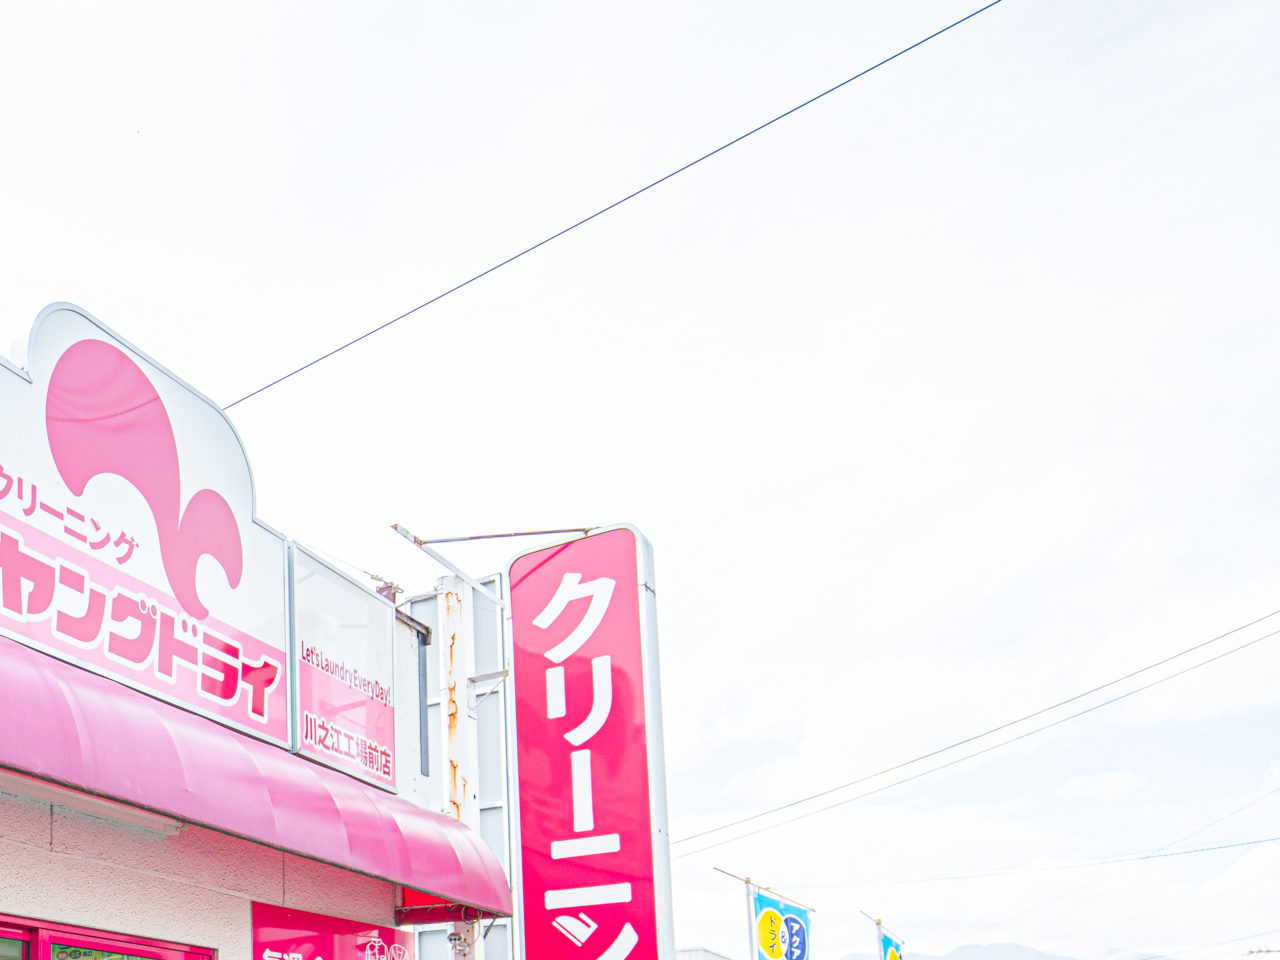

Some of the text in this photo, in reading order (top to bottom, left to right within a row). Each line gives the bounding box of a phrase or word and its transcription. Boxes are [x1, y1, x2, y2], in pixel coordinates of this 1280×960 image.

[304, 713, 392, 776] 川之江工場前店
